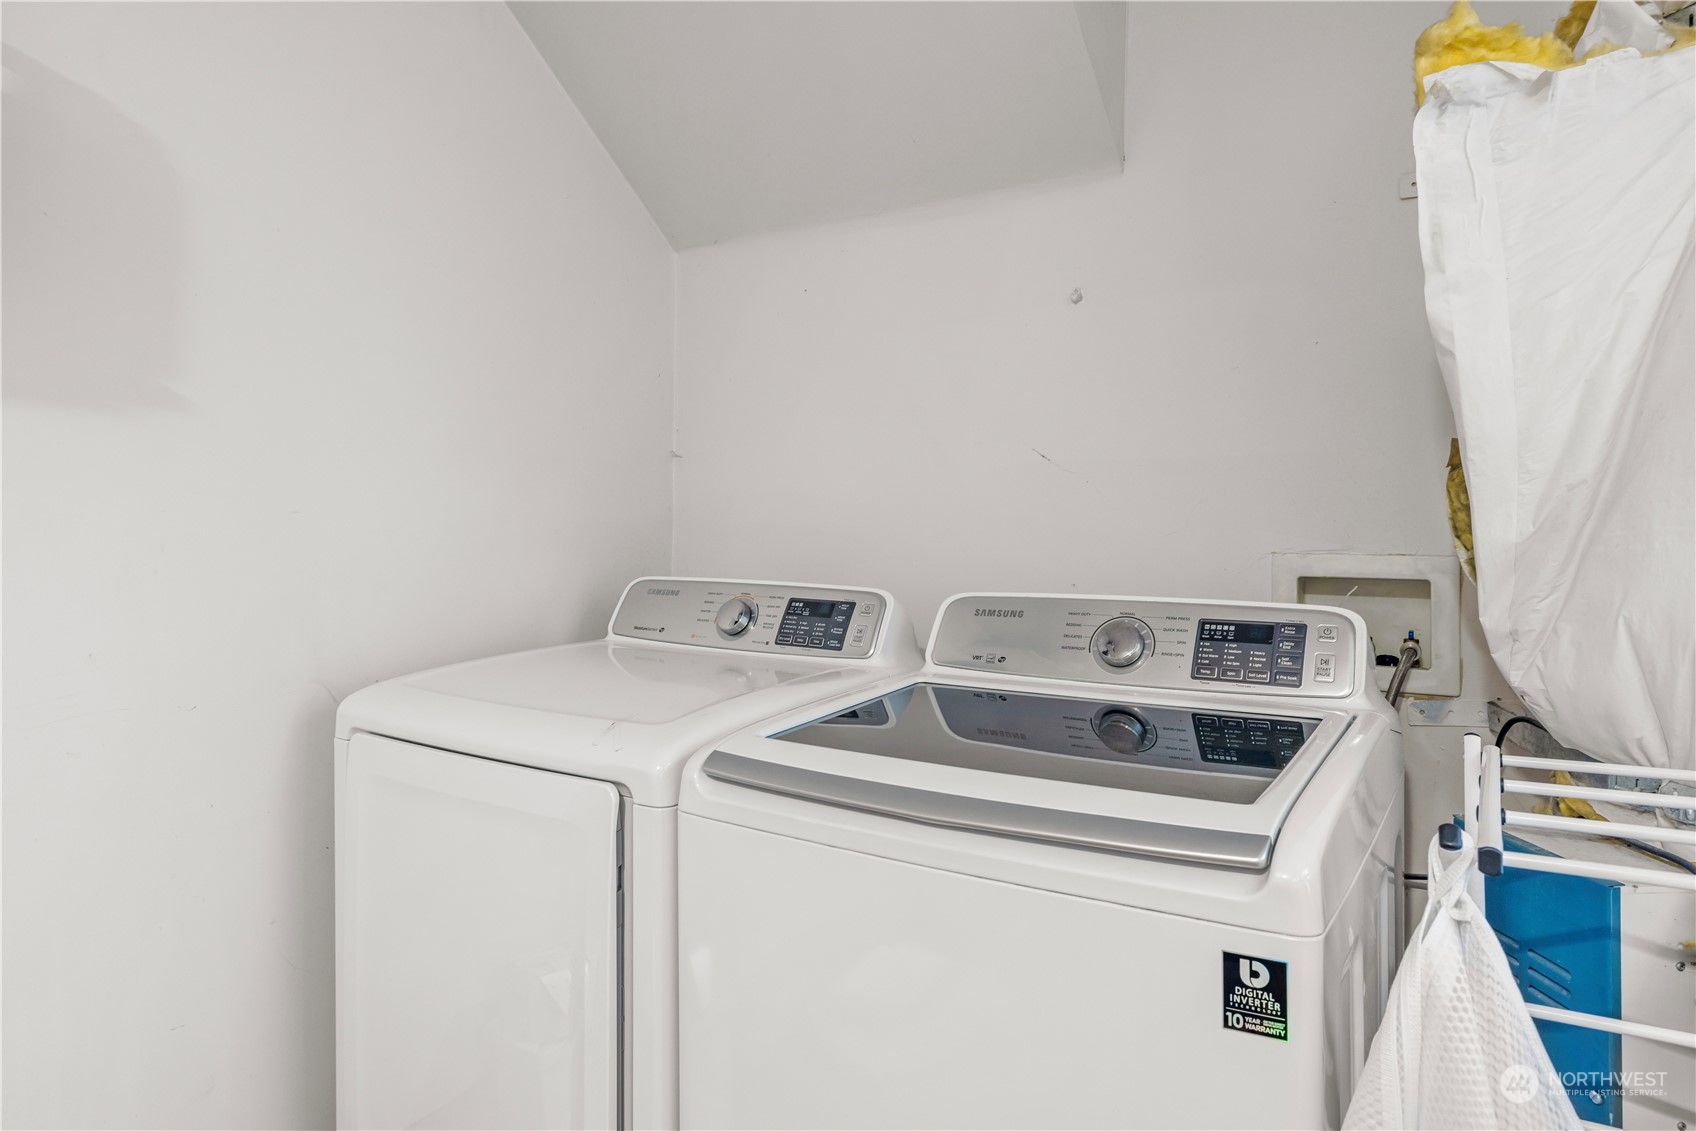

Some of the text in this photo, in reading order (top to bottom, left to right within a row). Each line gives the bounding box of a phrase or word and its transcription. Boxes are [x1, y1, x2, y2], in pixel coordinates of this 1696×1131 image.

[647, 588, 680, 596] SAMSUNG
[974, 608, 1024, 618] SAMSUNG
[1235, 986, 1275, 1002] DIGITAL
[1230, 994, 1280, 1011] INVERTER
[1225, 1012, 1261, 1028] 10 YEAR
[1245, 1023, 1285, 1037] WARRANTY
